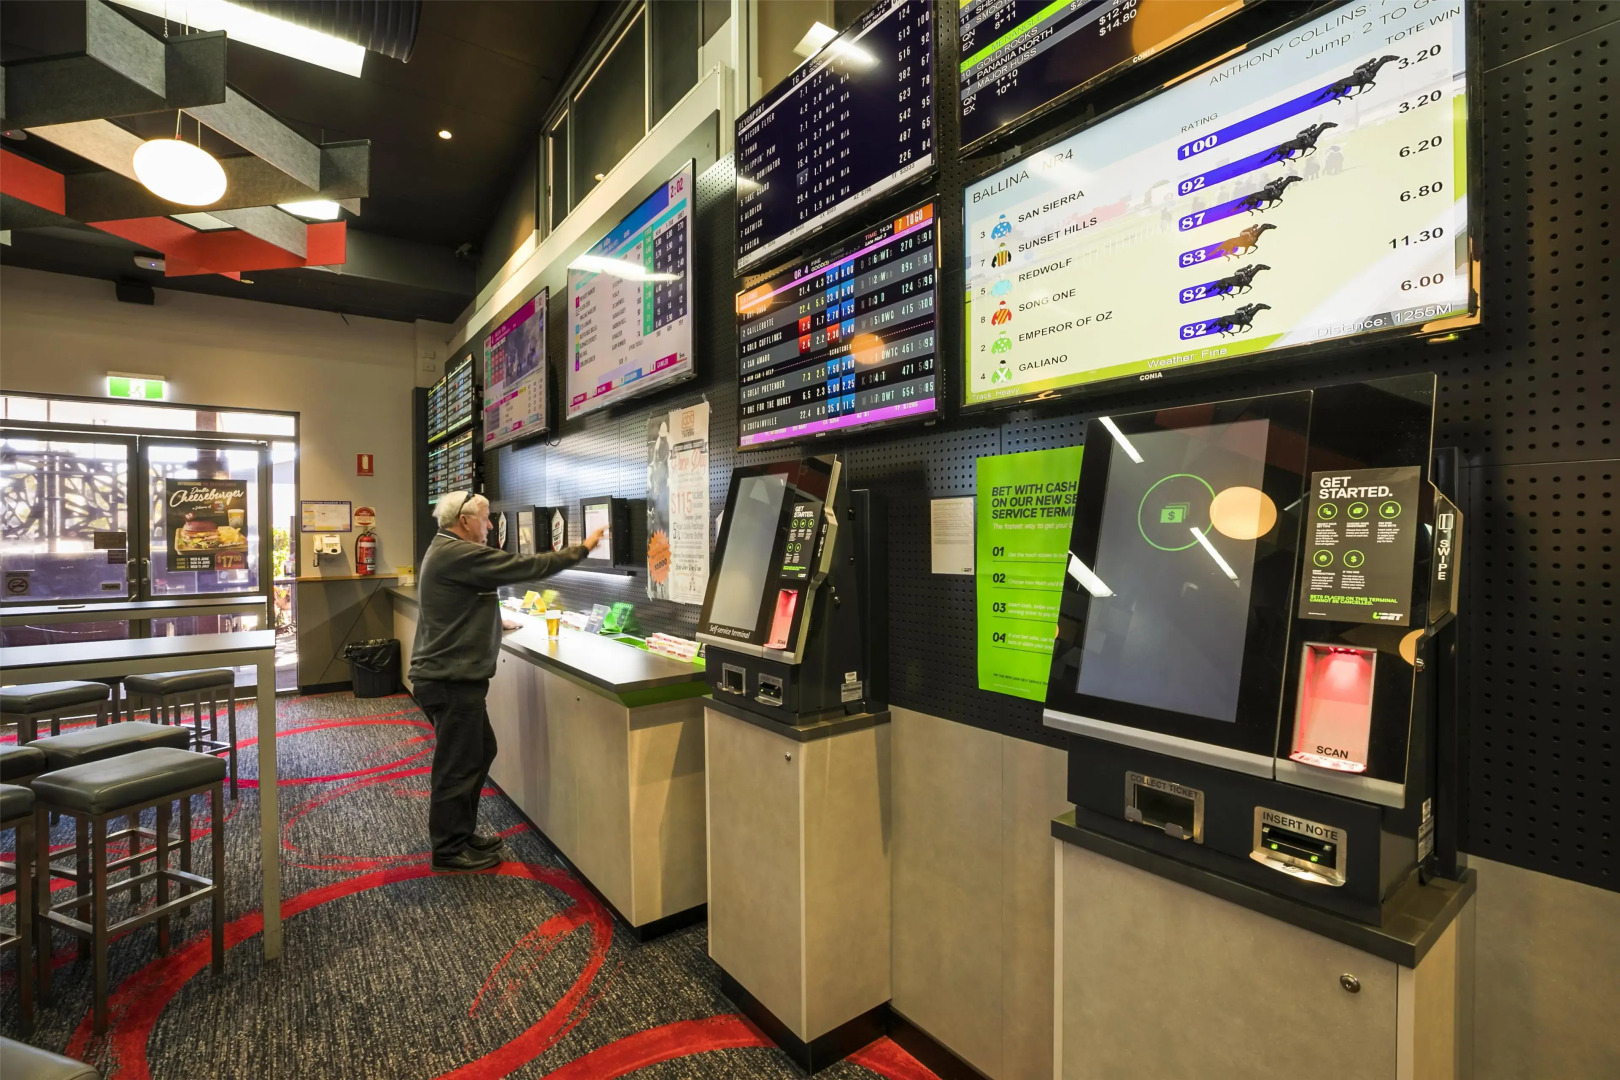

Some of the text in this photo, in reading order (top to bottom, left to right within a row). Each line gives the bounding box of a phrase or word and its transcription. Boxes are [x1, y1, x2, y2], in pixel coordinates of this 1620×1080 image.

[898, 5, 911, 21] 124
[917, 11, 931, 27] 100
[961, 14, 969, 25] 11
[1099, 0, 1137, 26] $12.40
[1362, 22, 1373, 35] 2
[1379, 7, 1407, 25] TO
[1099, 9, 1137, 37] $14.80
[1385, 6, 1461, 45] TOTE WIN
[898, 25, 911, 41] 513
[921, 32, 931, 46] 92
[962, 28, 976, 42] QN
[991, 13, 1043, 51] MENANGLE
[962, 38, 975, 52] EX
[977, 49, 1002, 70] GOLD
[1004, 26, 1038, 54] ROCKS
[977, 50, 1017, 80] PANANIA
[1018, 26, 1054, 54] NORTH
[898, 46, 911, 62] 516
[921, 52, 931, 67] 67
[1398, 44, 1442, 70] 3.20
[977, 65, 1008, 89] MAJOR
[1010, 47, 1037, 69] HUSS
[1209, 43, 1284, 87] ANTHONY
[898, 66, 911, 82] 382
[921, 74, 931, 88] 78
[921, 95, 931, 109] 95
[963, 93, 977, 106] QN
[1398, 89, 1442, 114] 3.20
[898, 107, 911, 123] 542
[963, 103, 976, 116] EX
[921, 116, 931, 130] 65
[1180, 112, 1218, 134] RATING
[898, 128, 911, 143] 487
[921, 138, 931, 151] 84
[1182, 134, 1218, 158] 100
[1399, 135, 1443, 158] 6.20
[898, 149, 911, 164] 226
[972, 148, 1074, 204] BALLINA NR4
[670, 177, 684, 199] 2:02
[1181, 176, 1206, 195] 92
[1399, 181, 1444, 203] 6.80
[906, 209, 923, 227] TOGO
[980, 190, 1085, 240] 3 SAN SIERRA
[1182, 212, 1206, 230] 87
[864, 231, 878, 241] TIME
[980, 216, 1098, 268] 7 SUNSET HILLS
[1388, 226, 1444, 250] 11.30
[1182, 249, 1207, 267] 83
[980, 257, 1072, 296] 5 REDWOLF
[1400, 272, 1445, 292] 6.00
[901, 281, 914, 294] 124
[1182, 286, 1207, 302] 82
[902, 303, 914, 315] 415
[980, 288, 1077, 325] 8 SONG ONE
[1316, 303, 1454, 339] Distance: 1255M
[980, 311, 1113, 353] 2 EMPEROR OF OZ
[1182, 322, 1207, 339] 82
[816, 334, 825, 345] 2.2
[902, 342, 914, 353] 461
[1201, 345, 1228, 360] Fine
[902, 363, 914, 376] 471
[980, 354, 1068, 381] 4 GALIANO
[842, 378, 855, 390] 2.25
[1139, 371, 1163, 382] CONIA
[761, 379, 786, 394] PRETENDER
[816, 386, 826, 397] 2.3
[776, 395, 792, 407] MONEY
[992, 481, 1077, 497] BET WITH CASH
[1319, 476, 1352, 489] GET
[169, 488, 244, 508] Cheeseburger
[992, 497, 1007, 508] ON
[1009, 496, 1033, 507] OUR
[1035, 494, 1063, 506] NEW
[1319, 486, 1394, 500] STARTED.
[991, 507, 1038, 519] SERVICE
[992, 546, 1005, 557] 01
[1437, 539, 1450, 581] SWIPE
[992, 573, 1006, 584] 02
[992, 602, 1006, 613] 03
[731, 628, 751, 639] terminal
[992, 632, 1006, 643] 04
[1316, 745, 1349, 760] SCAN
[1130, 773, 1199, 799] COLLECT TICKET
[1262, 811, 1339, 841] INSERT NOTE
